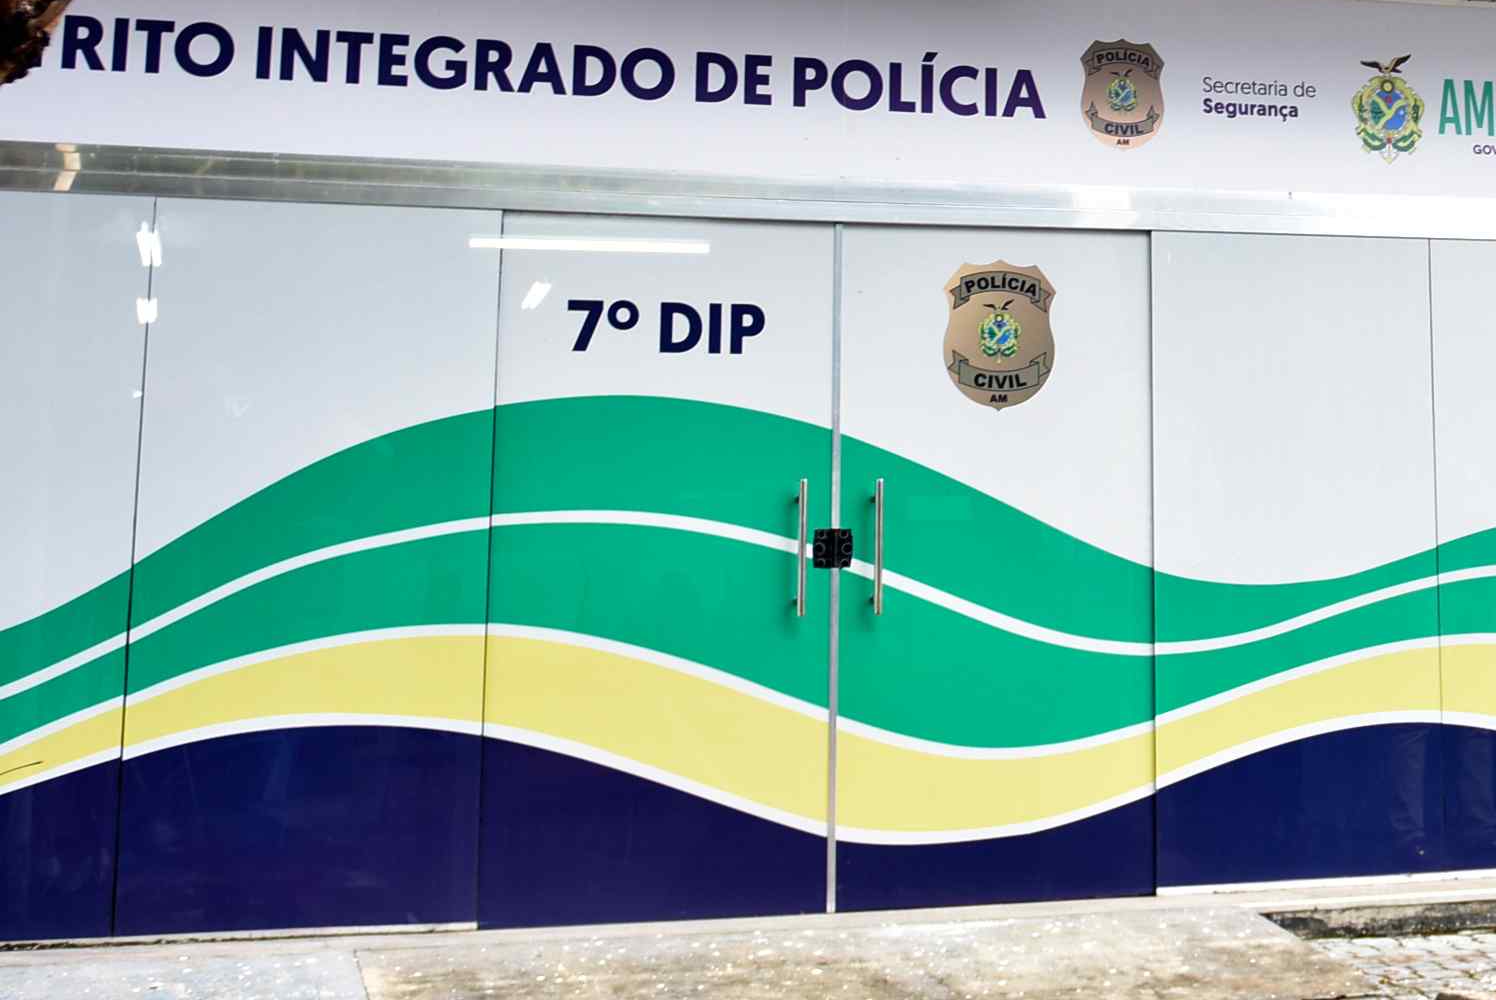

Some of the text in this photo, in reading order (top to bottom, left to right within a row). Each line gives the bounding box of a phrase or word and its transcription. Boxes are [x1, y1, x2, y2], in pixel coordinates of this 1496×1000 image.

[36, 15, 1046, 119] RITO INTEGRADO DE POLÍCIA
[1096, 50, 1151, 67] POLÍCIA
[1202, 76, 1317, 98] Secretaria de
[1203, 97, 1299, 121] Segurança
[1104, 123, 1144, 135] CIVIL
[964, 273, 1037, 297] POLÍCIA
[659, 301, 766, 355] DIP
[974, 372, 1027, 389] CIVIL
[989, 394, 1009, 404] AM
